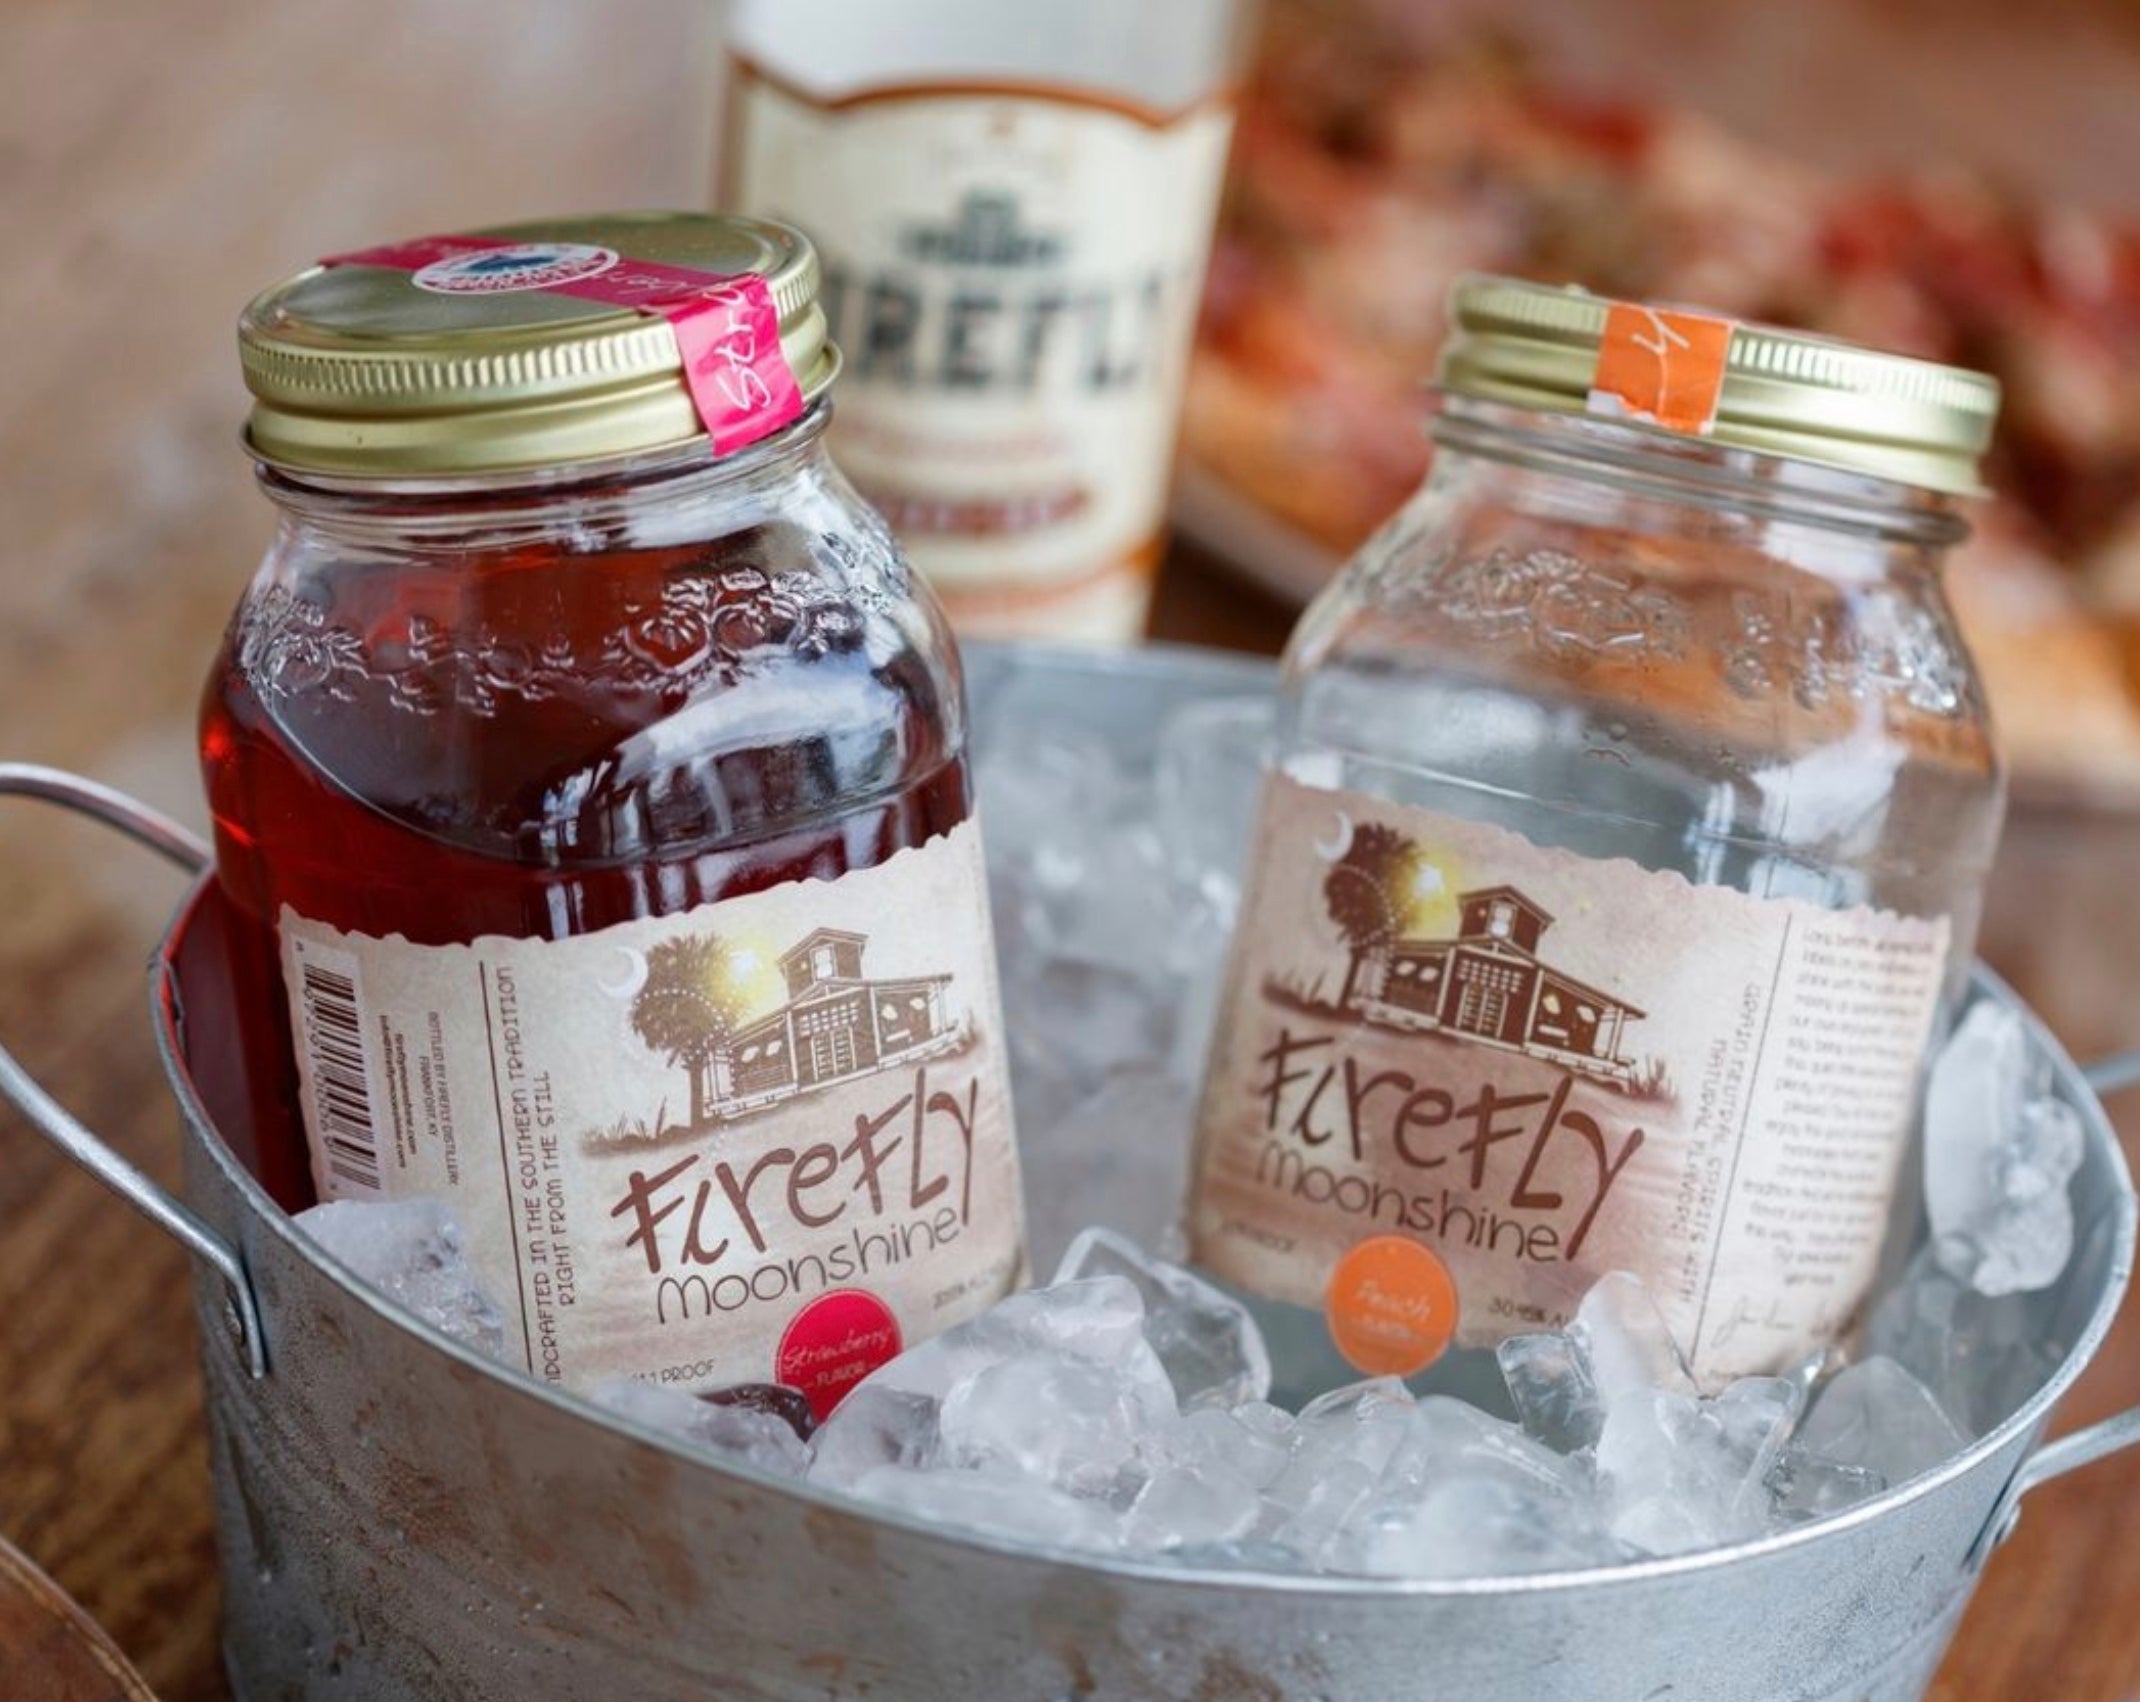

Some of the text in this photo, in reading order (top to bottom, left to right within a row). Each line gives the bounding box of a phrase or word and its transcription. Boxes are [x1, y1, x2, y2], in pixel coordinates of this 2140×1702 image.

[496, 966, 525, 1081] TRADITION
[511, 1088, 538, 1190] SOUTHERN
[533, 1070, 575, 1306] RIGHT FROM THE STILL
[524, 1196, 544, 1233] THE
[534, 1272, 562, 1381] DCRAFTED
[661, 1359, 715, 1384] PROOF
